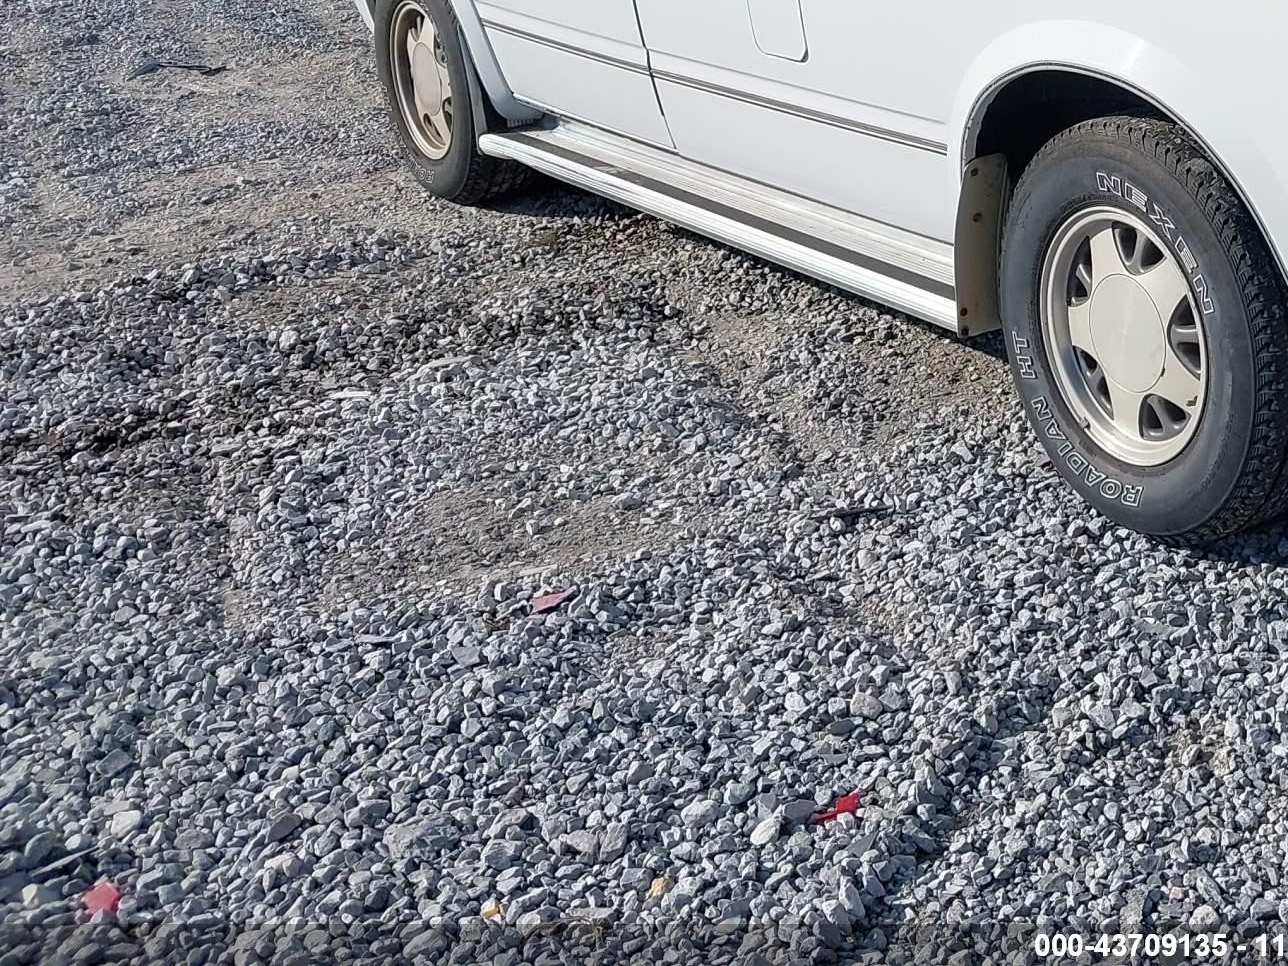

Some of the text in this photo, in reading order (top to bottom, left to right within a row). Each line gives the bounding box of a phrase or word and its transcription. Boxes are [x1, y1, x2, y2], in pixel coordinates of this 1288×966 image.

[1095, 171, 1215, 316] NEXEN
[1011, 331, 1145, 508] ROADIAN HT
